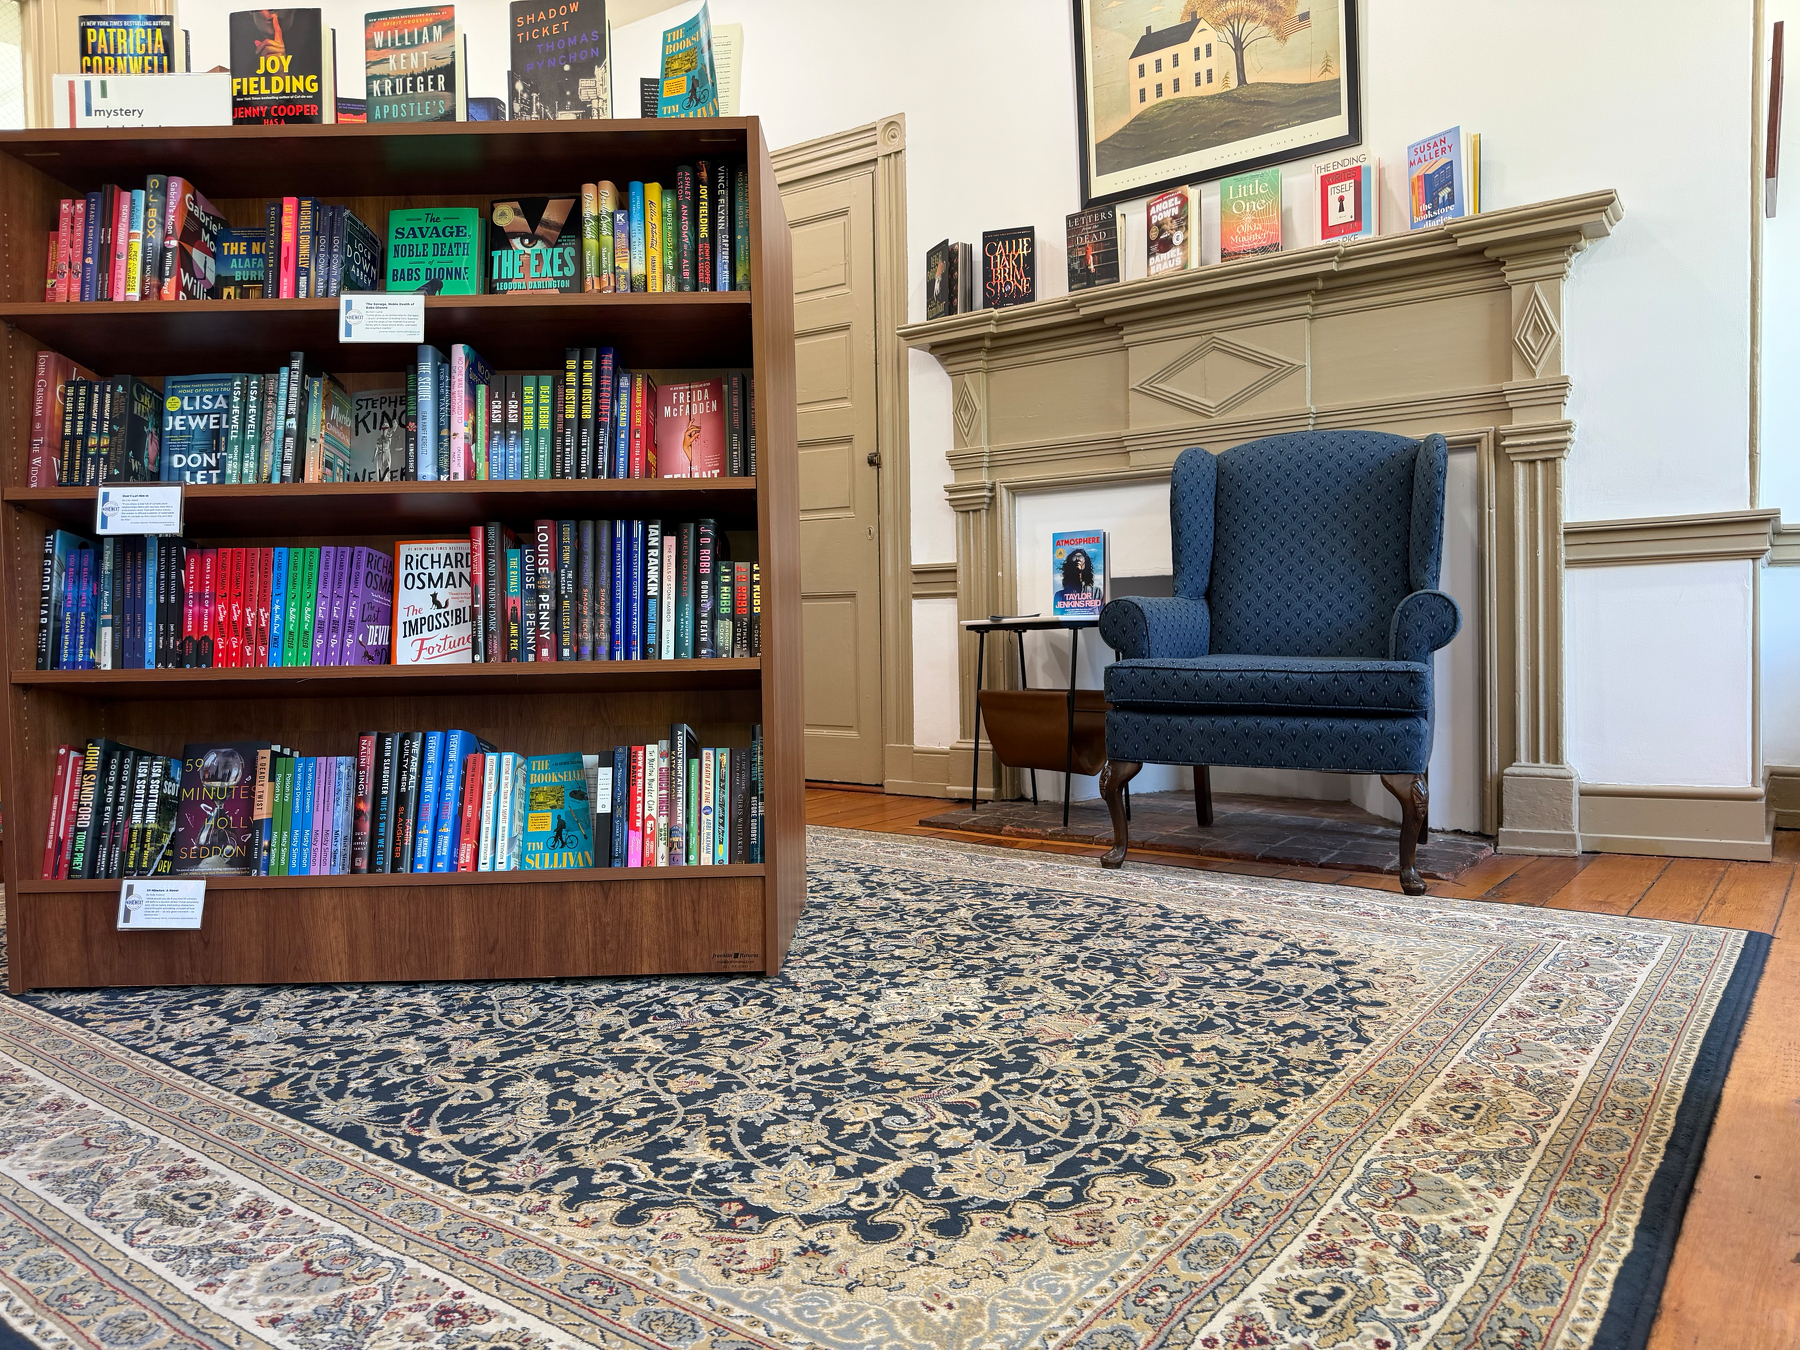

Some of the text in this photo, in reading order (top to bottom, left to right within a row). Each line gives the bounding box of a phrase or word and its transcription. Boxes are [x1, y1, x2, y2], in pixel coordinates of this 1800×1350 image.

[517, 1, 579, 27] SHADOW
[86, 28, 164, 54] PATRICIA
[374, 25, 442, 48] WILLIAM
[517, 20, 569, 43] TICKET
[537, 30, 599, 54] THOMAS
[256, 55, 292, 74] JOY
[389, 51, 429, 71] KENT
[526, 47, 599, 73] PYNCHON
[232, 74, 318, 96] FIELDING
[373, 74, 446, 96] KRUEGER
[94, 108, 144, 118] mystery
[233, 104, 318, 119] JENNY COOPER
[375, 100, 445, 120] APOSTLE'S
[1410, 144, 1454, 168] MALLERY
[1414, 136, 1446, 156] SUSAN
[1316, 154, 1366, 174] THE ENDING
[1325, 168, 1356, 184] WRITES
[1229, 180, 1269, 200] Little
[1330, 182, 1353, 196] ITSELF
[88, 203, 96, 225] DEADLY
[285, 204, 293, 215] EAT
[1150, 196, 1181, 216] ANGEL
[1152, 206, 1178, 224] DOWN
[1232, 198, 1266, 214] One
[1414, 204, 1455, 224] bookstore
[1420, 202, 1432, 213] the
[146, 208, 157, 238] BOX
[284, 216, 292, 230] SLAY
[424, 213, 442, 223] The
[681, 204, 689, 243] ANATOMY
[1068, 210, 1113, 228] LETTERS
[163, 182, 178, 294] Gabriel's Moon William Boyd
[299, 200, 311, 269] MICHAEL CONNELLY
[394, 225, 472, 240] SAVAGE,
[1076, 231, 1106, 245] DEAD
[393, 242, 470, 258] NOBLE DEATH
[985, 237, 1032, 257] CALLIE
[1149, 248, 1182, 266] DANIEL
[492, 246, 576, 279] THE EXES
[682, 259, 690, 279] ALIBI
[990, 252, 1024, 270] HART
[1150, 256, 1182, 274] KRAUS
[392, 266, 469, 282] BABS DIONNE
[496, 279, 570, 291] LEODORA DARLINGTON
[986, 277, 1032, 298] STONE
[34, 354, 49, 417] JOHN GRISHAM
[418, 362, 431, 402] THE SEQUEL
[565, 360, 576, 419] DO NOT DISTURB
[598, 354, 612, 423] THE INTRUDER
[182, 394, 229, 411] LISA
[672, 388, 709, 404] FREIDA
[492, 400, 502, 423] CRASH
[523, 386, 533, 431] DEAR DEBBIE
[664, 400, 717, 417] McFADDEN
[164, 414, 229, 431] JEWEL
[30, 437, 43, 488] THE WIDOW
[186, 470, 221, 484] LET
[44, 534, 53, 553] THE
[488, 526, 496, 556] BRIGHT
[537, 526, 549, 574] LOUISE
[699, 526, 711, 574] J. D. ROBB
[1056, 536, 1100, 547] ATMOSPHERE
[404, 552, 470, 571] RiCHARD
[525, 549, 535, 589] LOUISE
[647, 524, 659, 596] IAN RANKIN
[404, 571, 471, 590] OSMAN
[510, 558, 518, 592] THE RIVALS
[488, 578, 496, 609] TENDER
[1064, 592, 1092, 600] TAYLOR
[41, 596, 49, 623] LIAR
[403, 605, 423, 617] The
[1055, 600, 1084, 608] JENKINS
[488, 611, 496, 632] DARK
[539, 594, 550, 640] PENNY
[510, 622, 518, 650] JANE PEK
[526, 613, 536, 651] PENNY
[410, 633, 472, 662] Fortune
[185, 758, 204, 772] 59
[382, 737, 392, 794] KARIN SLAUGHTER
[530, 760, 550, 771] THE
[76, 743, 101, 827] JOHN SANDFORD
[530, 769, 585, 784] BOOKSELLER
[131, 762, 148, 824] LISA SCOTTOLINE
[181, 786, 256, 801] MINUTES
[256, 790, 264, 811] TWIST
[659, 767, 669, 818] CHUCK TINGLE
[394, 806, 405, 858] SLAUGHTER
[72, 831, 86, 870] TOXIC PREY
[179, 845, 246, 859] SEDDON
[527, 842, 543, 851] TIM
[525, 851, 593, 869] SULLIVAN
